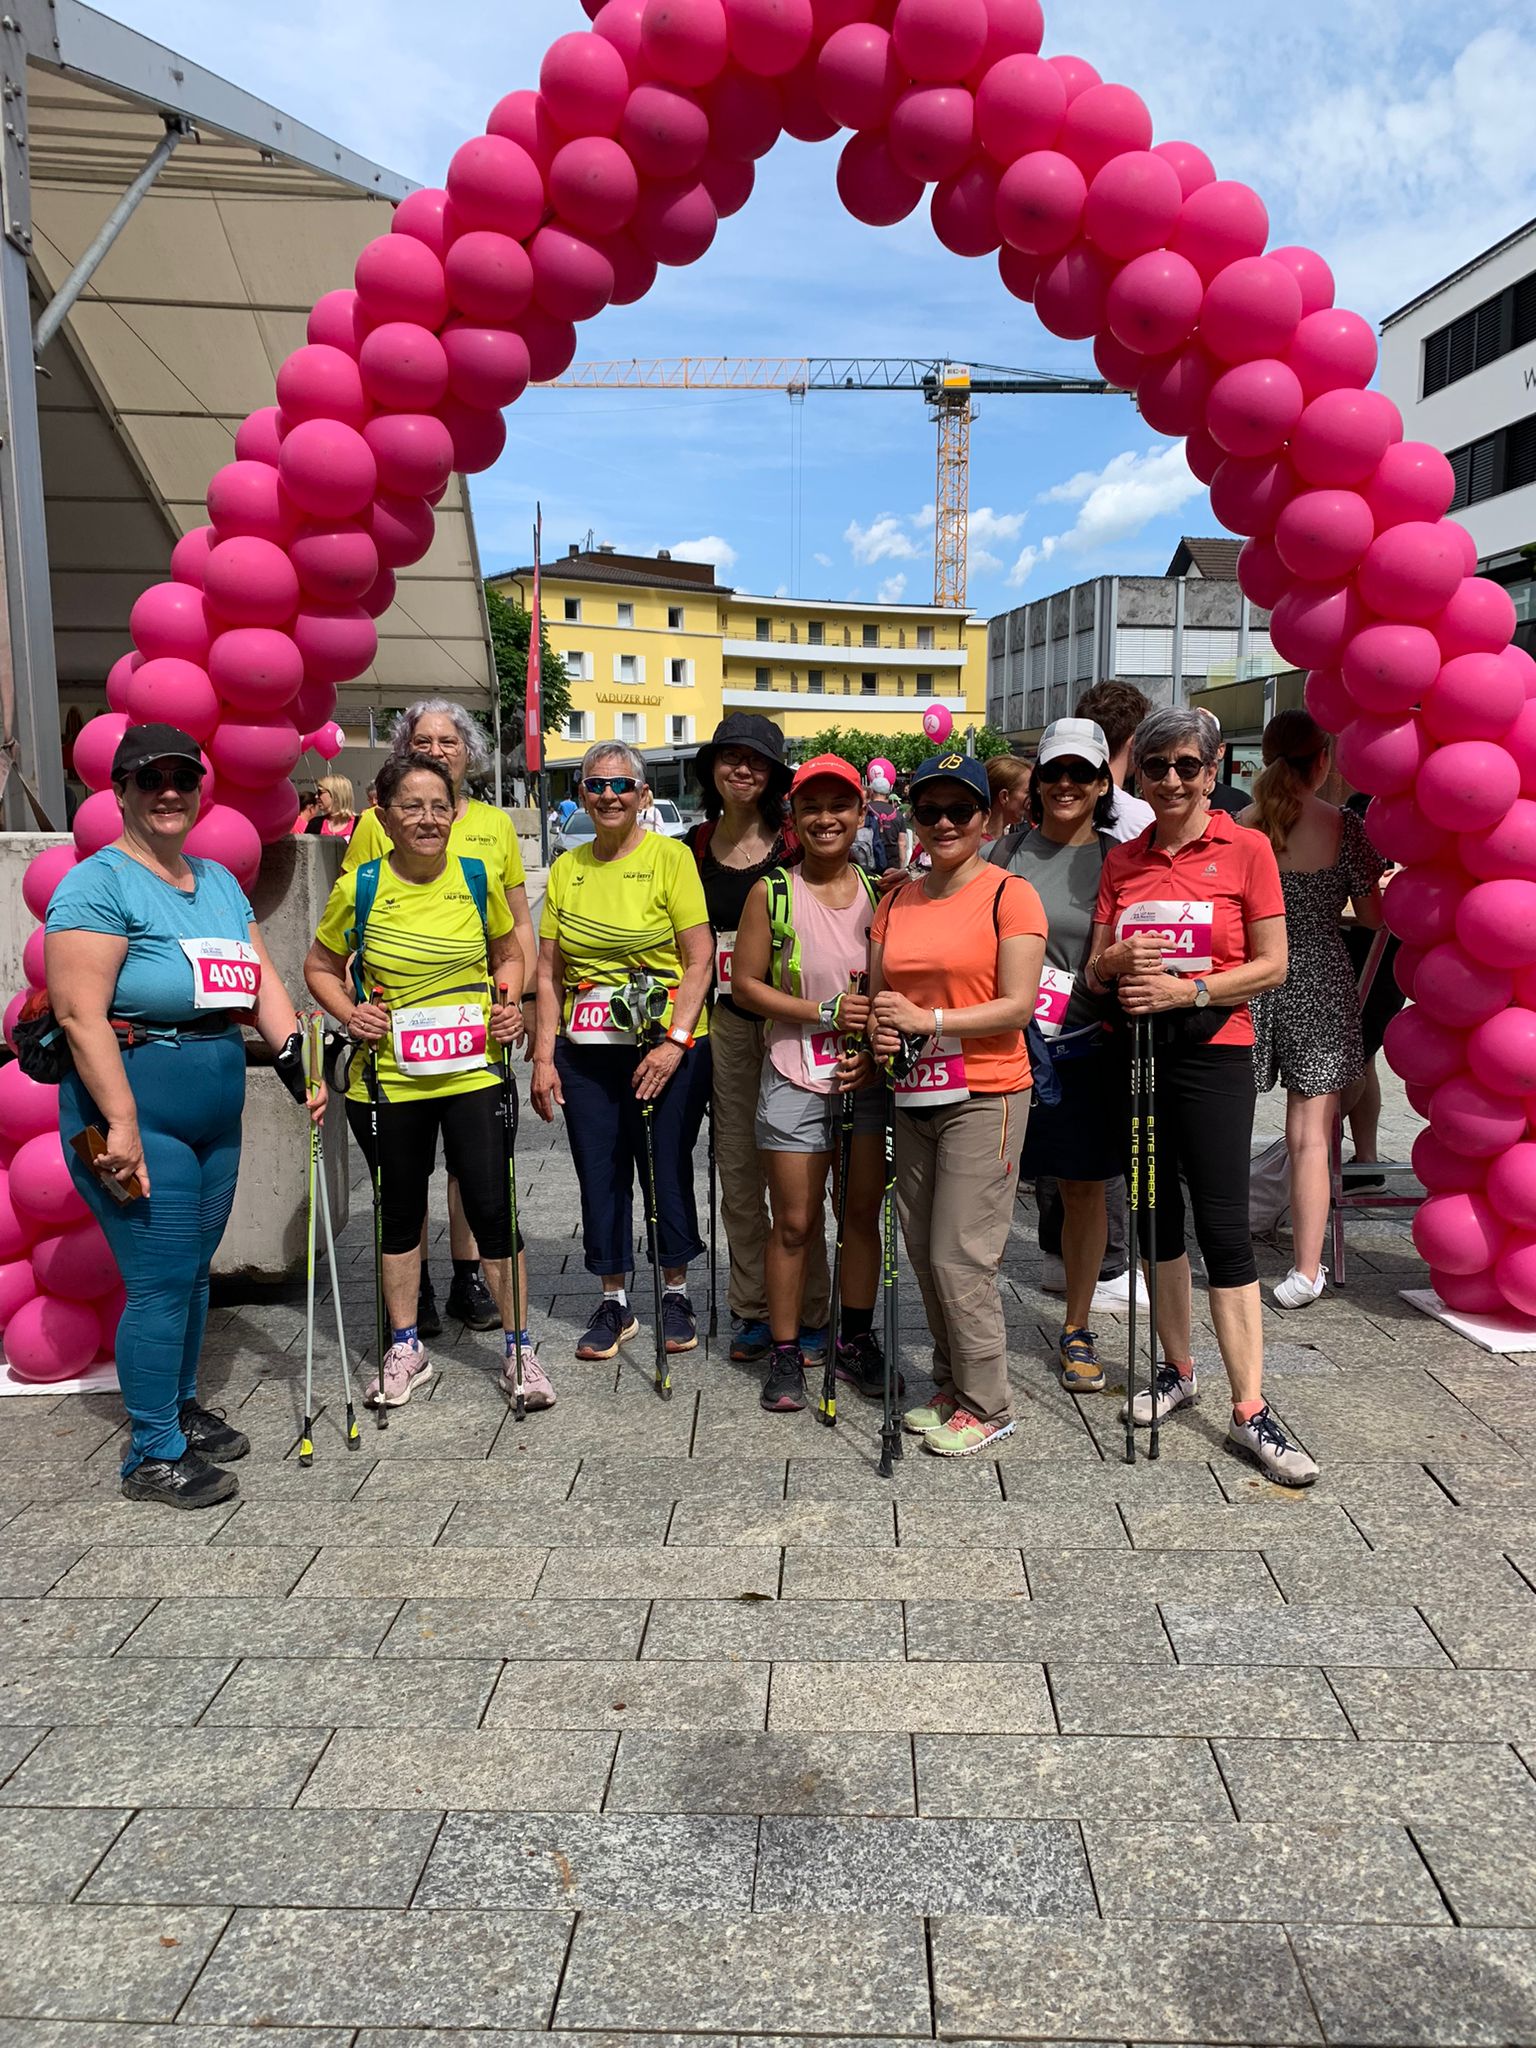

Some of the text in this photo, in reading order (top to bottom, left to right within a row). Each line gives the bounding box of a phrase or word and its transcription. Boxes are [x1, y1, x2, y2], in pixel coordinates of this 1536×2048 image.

[595, 692, 664, 706] VADUZER HOF
[1133, 929, 1195, 953] 24
[209, 963, 256, 990] 4019
[1034, 993, 1053, 1017] 2
[410, 1031, 473, 1058] 4018
[885, 1126, 893, 1162] LEKI
[1131, 1117, 1140, 1211] ELITE CARBON
[1147, 1116, 1156, 1209] ELITE CARBON
